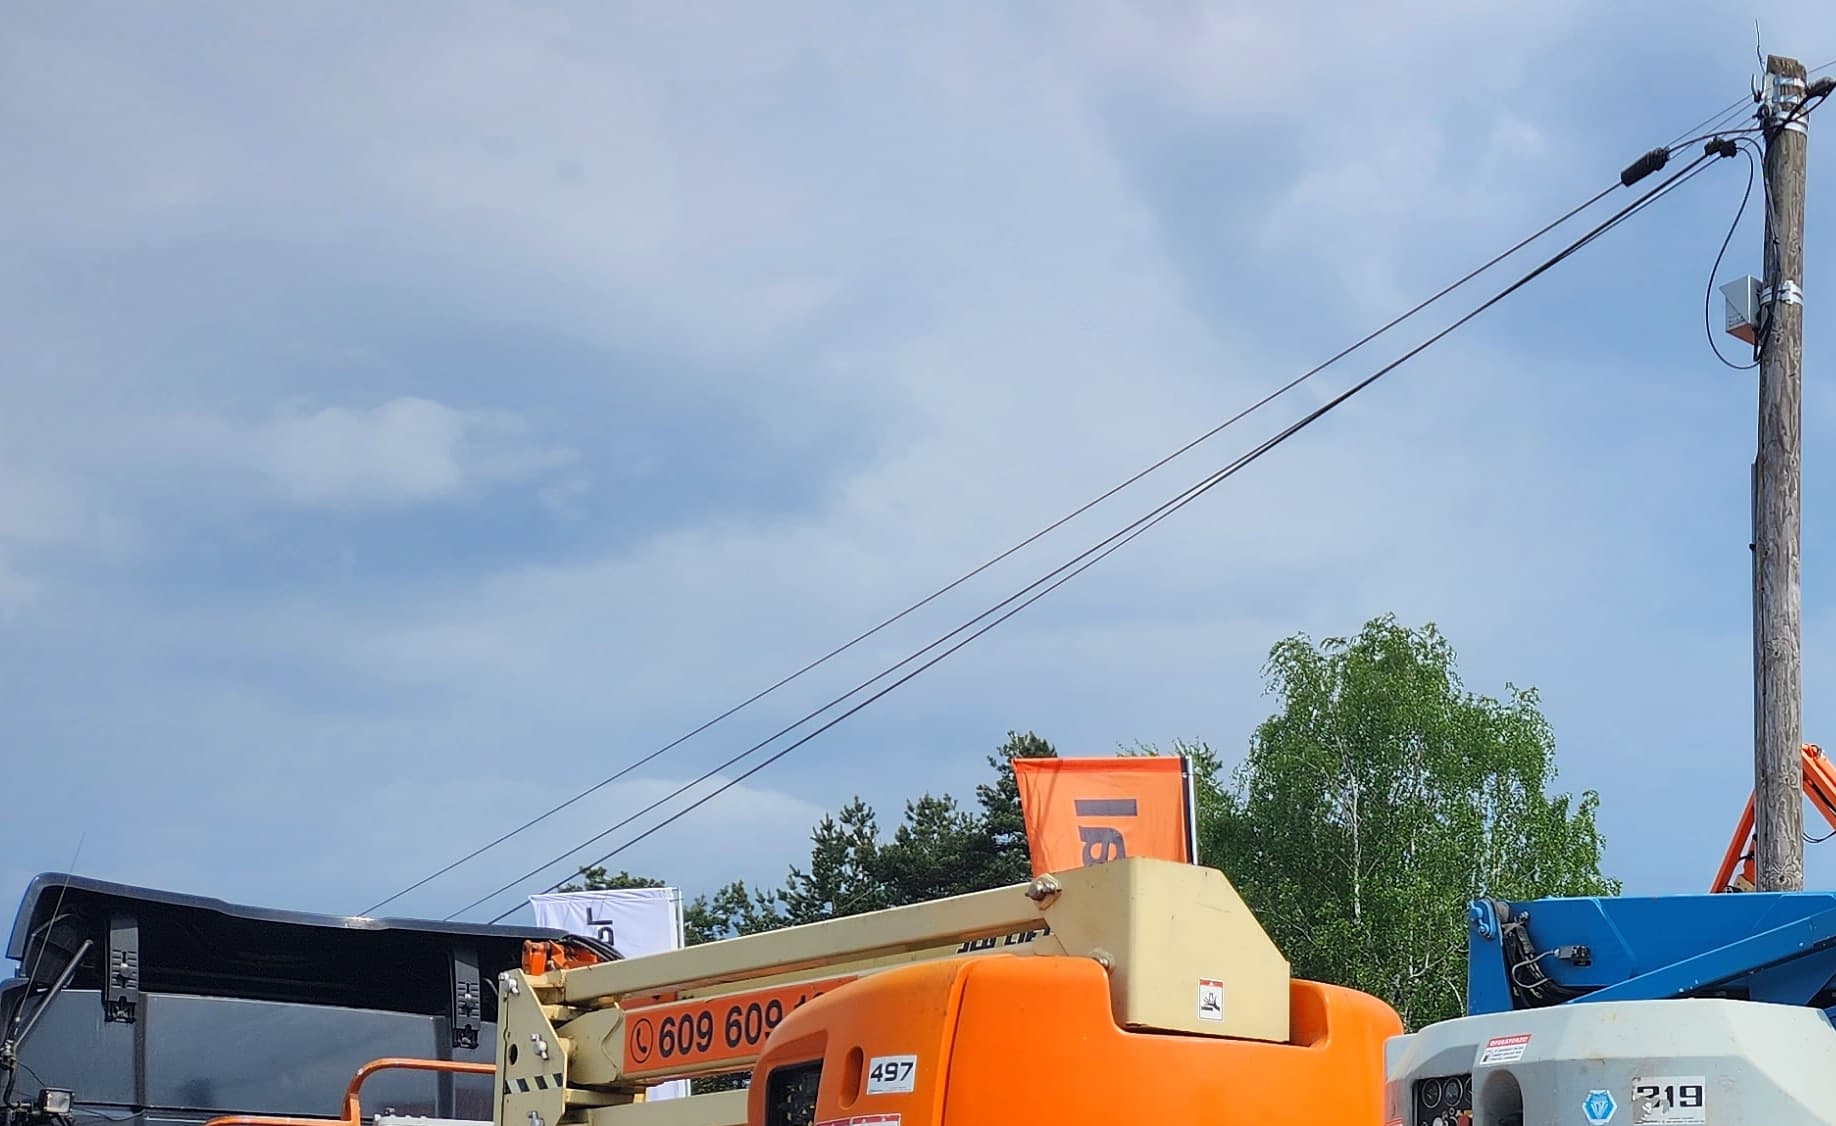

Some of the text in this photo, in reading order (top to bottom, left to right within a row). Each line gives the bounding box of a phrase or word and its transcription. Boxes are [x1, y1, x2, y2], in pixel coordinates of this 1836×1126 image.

[658, 998, 783, 1058] 609 609
[870, 1061, 914, 1083] 497
